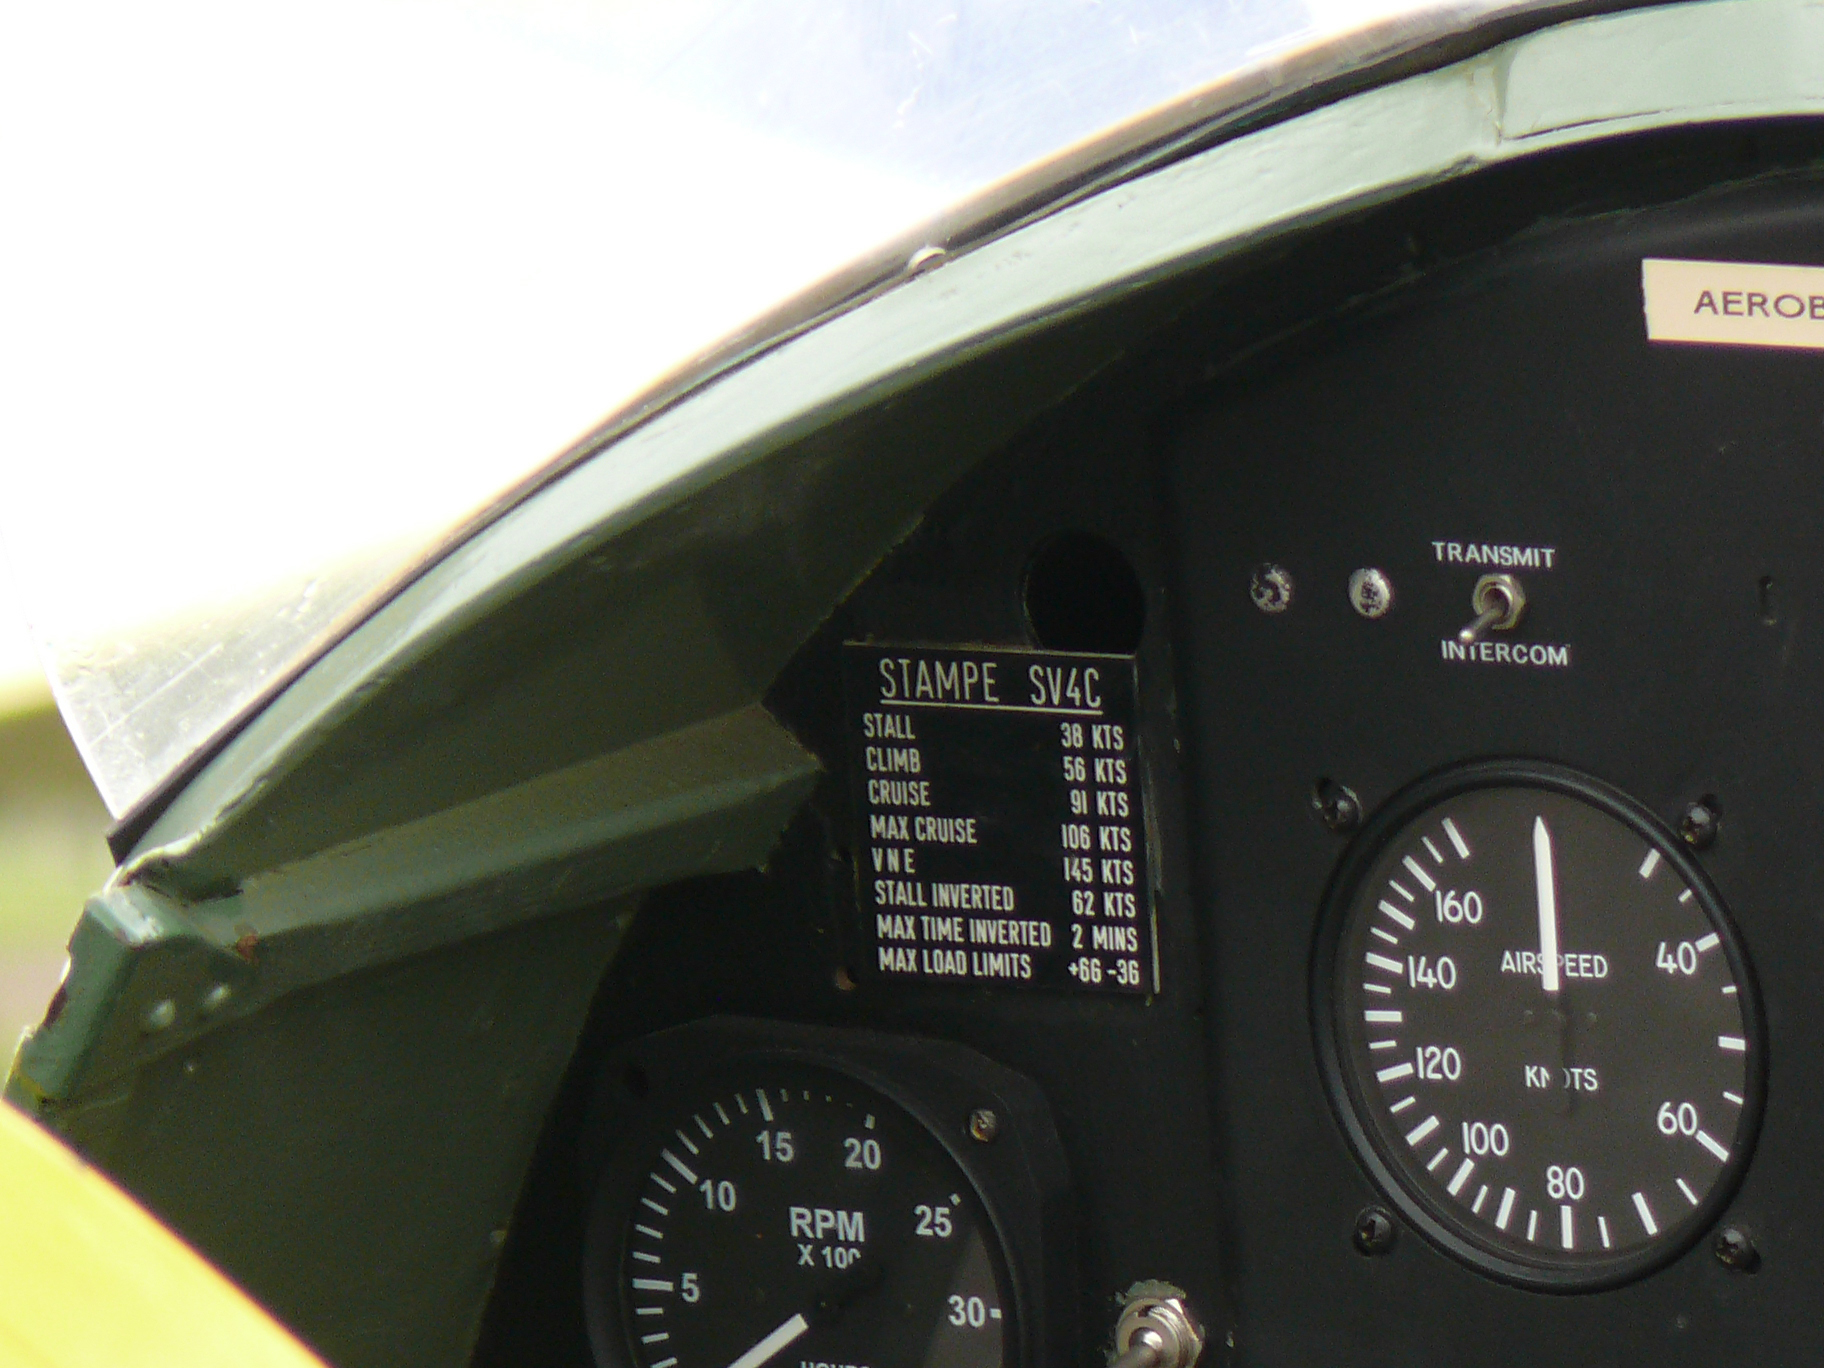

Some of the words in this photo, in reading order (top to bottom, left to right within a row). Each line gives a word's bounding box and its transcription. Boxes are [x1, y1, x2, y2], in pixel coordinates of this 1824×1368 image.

[1431, 541, 1556, 569] TRANSMIT
[1441, 640, 1569, 667] INTERCOM
[880, 658, 1000, 703] STAMPE
[1029, 664, 1102, 709] SV4C
[863, 712, 916, 740] STALL
[1060, 722, 1083, 749] 38
[1091, 724, 1124, 751] KTS
[865, 747, 921, 774] CLIMB
[1063, 756, 1086, 783] 56
[1094, 758, 1128, 785] KTS
[868, 779, 931, 807] CRUISE
[1070, 790, 1088, 816] 91
[1096, 790, 1129, 818] KTS
[870, 814, 910, 842] MAX
[914, 816, 978, 845] CRUISE
[1061, 823, 1091, 850] 106
[1099, 824, 1132, 852] KTS
[1063, 856, 1094, 885] 145
[1101, 857, 1134, 886] KTS
[874, 879, 928, 907] STALL
[932, 882, 1015, 912] INVERTED
[1071, 889, 1096, 917] 62
[1103, 891, 1136, 919] KTS
[1434, 889, 1484, 925] 160
[876, 913, 916, 941] MAX
[919, 915, 965, 943] TIME
[969, 918, 1052, 948] INVERTED
[1071, 923, 1084, 950] 2
[1091, 925, 1138, 953] MINS
[878, 947, 917, 974] MAX
[922, 948, 968, 976] LOAD
[972, 951, 1032, 980] LIMITS
[1406, 955, 1457, 990] 140
[1655, 941, 1698, 975] 40
[1415, 1045, 1462, 1081] 120
[1656, 1101, 1700, 1136] 60
[755, 1129, 795, 1163] 15
[843, 1137, 883, 1171] 20
[1460, 1121, 1511, 1157] 100
[699, 1178, 737, 1212] 10
[1545, 1165, 1586, 1200] 80
[789, 1206, 866, 1243] RPM
[913, 1203, 953, 1238] 25
[797, 1243, 815, 1267] X
[680, 1272, 700, 1303] 5
[947, 1294, 986, 1328] 30
